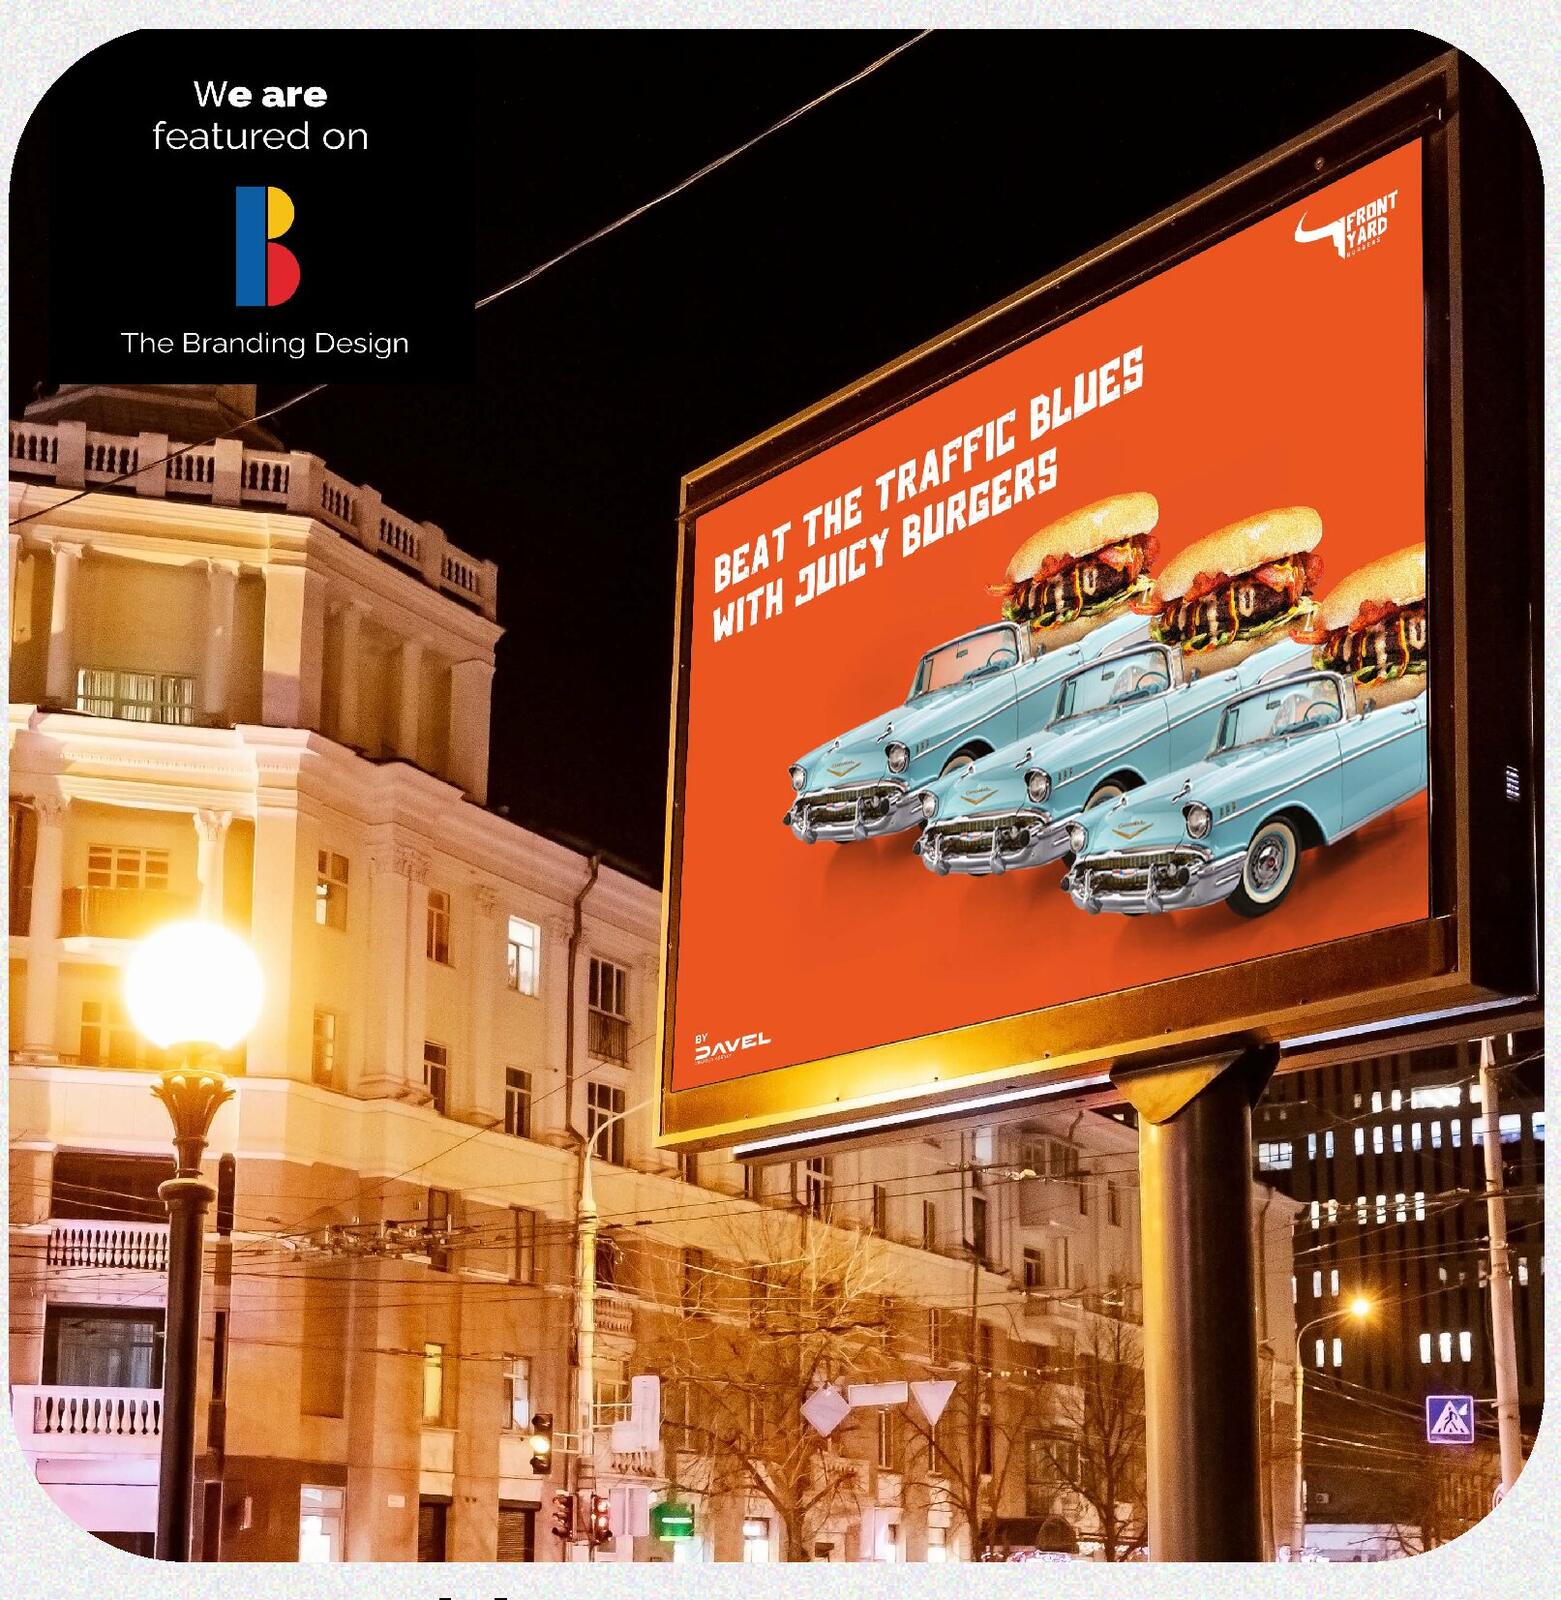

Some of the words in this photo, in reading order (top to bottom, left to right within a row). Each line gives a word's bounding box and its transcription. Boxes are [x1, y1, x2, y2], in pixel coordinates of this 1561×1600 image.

[1346, 189, 1399, 233] FRONT
[1346, 216, 1388, 249] YARD
[714, 521, 792, 593] BEAT
[802, 486, 863, 548] THE
[875, 409, 1017, 512] TRAFFIC
[1030, 345, 1144, 441] BLUES
[712, 578, 784, 643] WITH
[794, 527, 890, 608] JUICY
[902, 446, 1058, 558] BURGERS
[695, 1032, 709, 1045] BY
[695, 1031, 772, 1061] DAVEL
